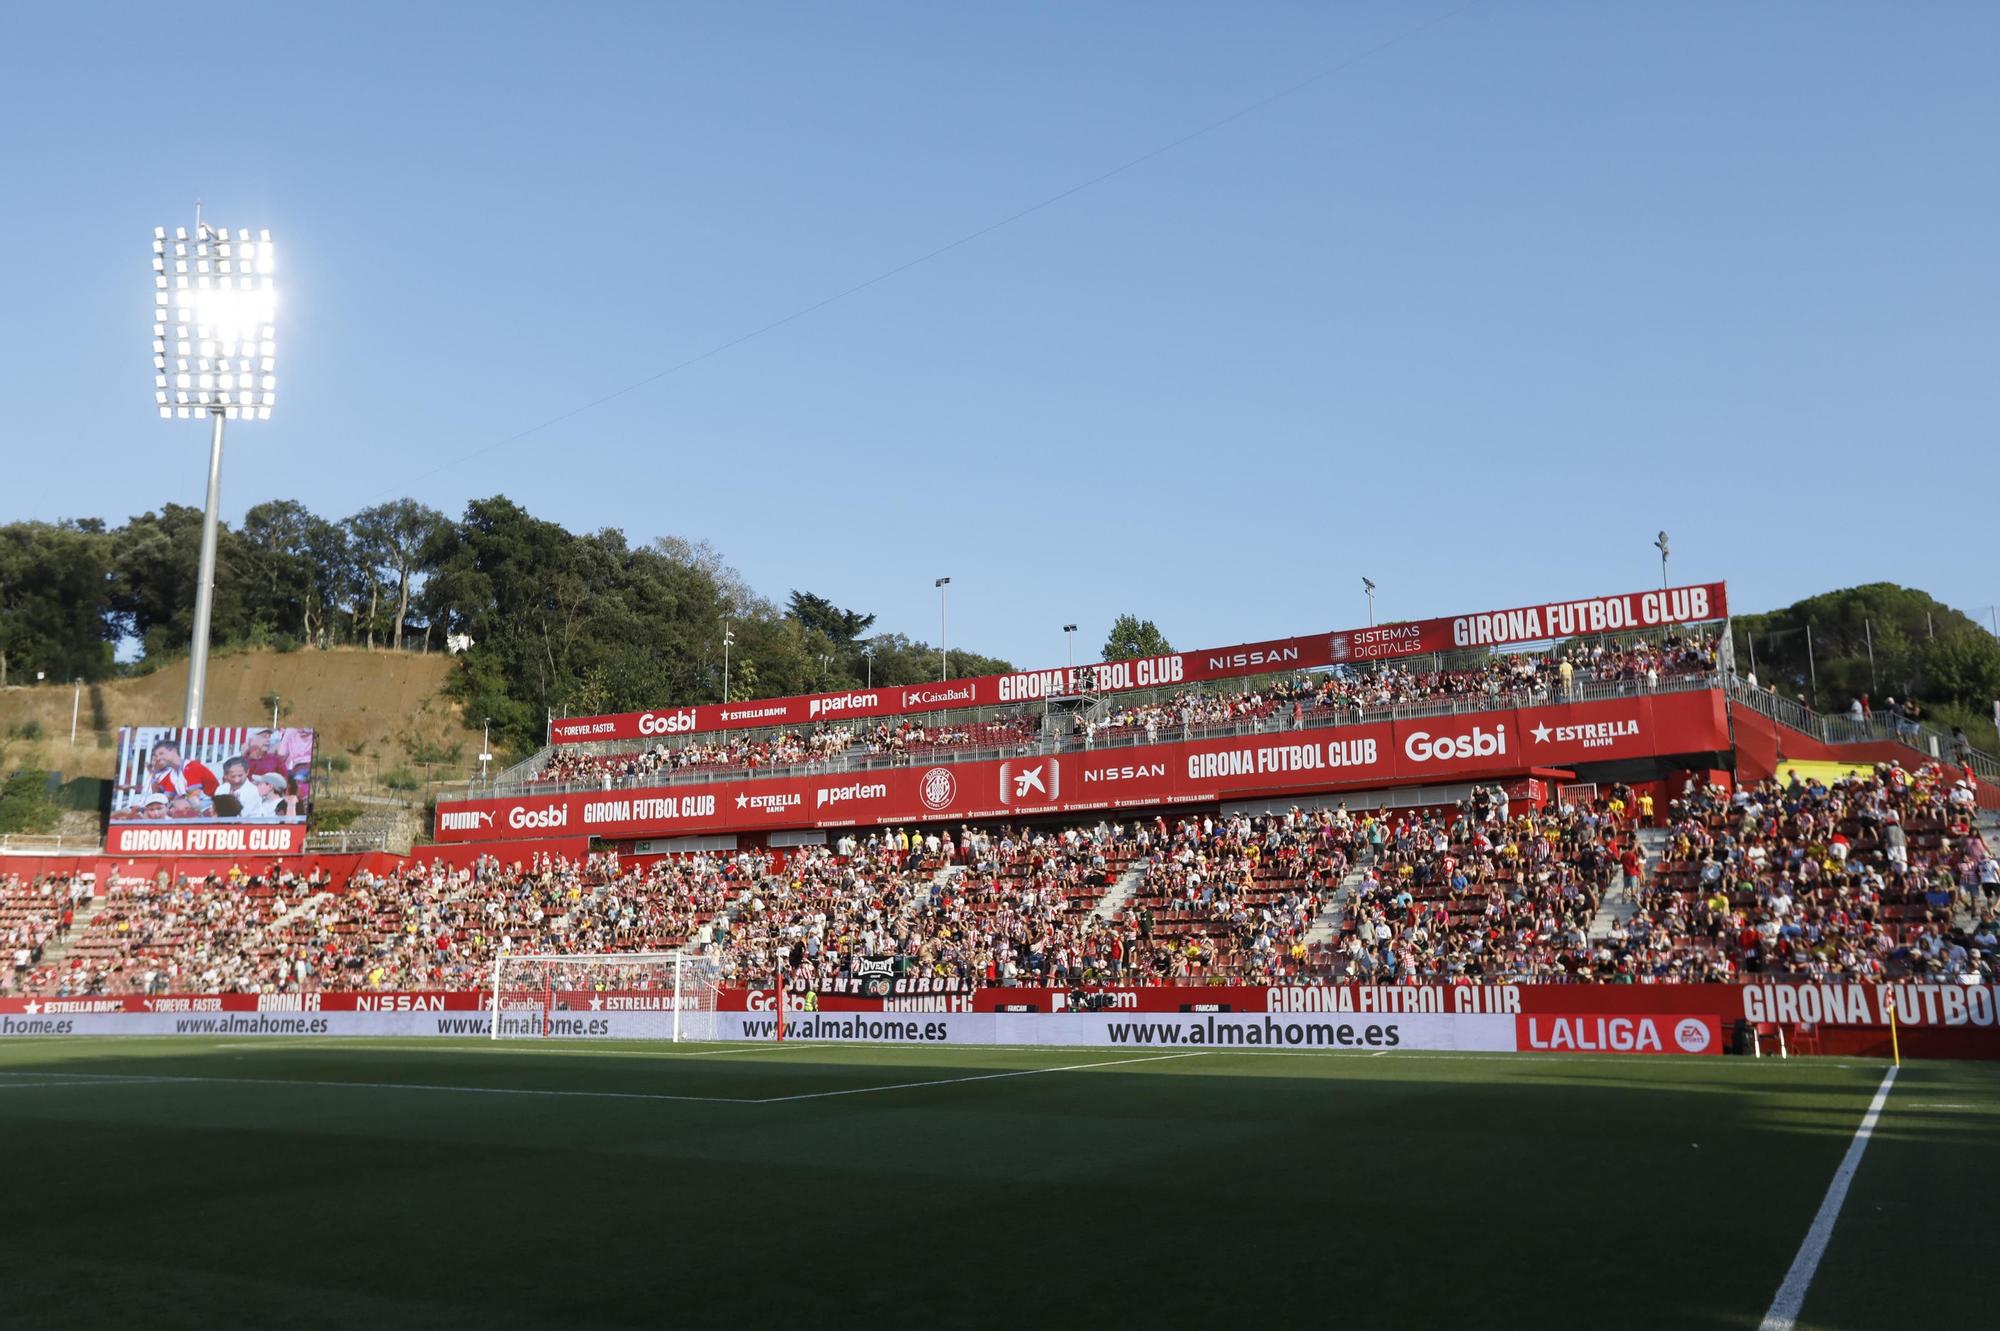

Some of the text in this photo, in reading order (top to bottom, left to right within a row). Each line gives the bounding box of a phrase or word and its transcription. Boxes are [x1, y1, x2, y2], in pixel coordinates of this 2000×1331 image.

[1453, 587, 1710, 647] GIRONA FUTBOL CLUB
[1354, 625, 1420, 645] SISTEMAS
[1209, 647, 1298, 670] NISSAN
[1354, 639, 1421, 658] DIGITALES
[999, 671, 1064, 701] GIRONA
[1137, 655, 1183, 686] CLUB
[822, 692, 878, 716] parlem
[922, 687, 969, 703] CaixaBank
[639, 709, 697, 735] Gosbi
[730, 707, 787, 720] ESTRELLA DAMM
[1556, 720, 1639, 742] ESTRELLA
[1405, 723, 1506, 762] Gosbi
[1583, 737, 1613, 748] DAMM
[1188, 738, 1377, 779] GIRONA FUTBOL CLUB
[1084, 763, 1165, 783] NISSAN
[750, 794, 801, 808] ESTRELLA
[829, 783, 886, 805] parlem
[508, 803, 568, 829] Gosbi
[584, 795, 715, 823] GIRONA FUTBOL CLUB
[441, 811, 480, 830] PUMA
[120, 829, 292, 851] GIRONA FUTBOL CLUB
[43, 1001, 93, 1013] ESTRELLA
[356, 995, 445, 1011] NISSAN
[606, 996, 660, 1010] ESTRELLA
[1742, 984, 1872, 1025] GIRONA
[176, 1014, 328, 1034] www.almahome.es
[1107, 1016, 1400, 1046] www.almahome.es
[1529, 1017, 1663, 1051] LALIGA
[1682, 1026, 1703, 1037] EA
